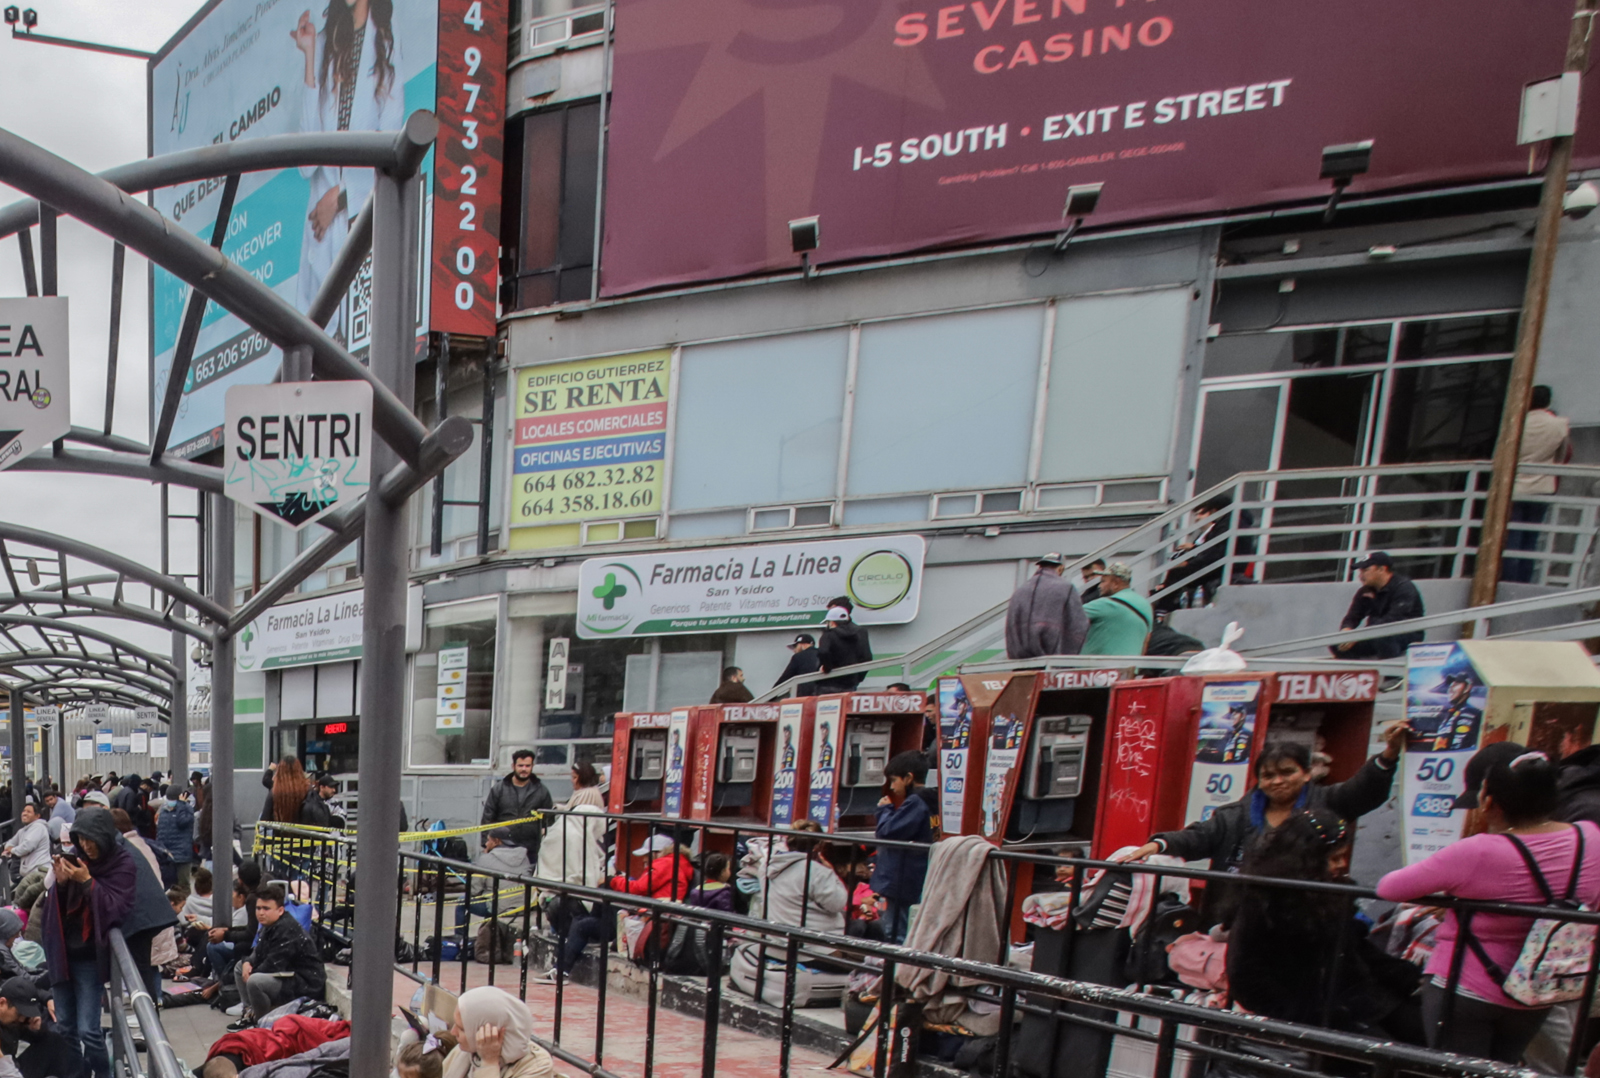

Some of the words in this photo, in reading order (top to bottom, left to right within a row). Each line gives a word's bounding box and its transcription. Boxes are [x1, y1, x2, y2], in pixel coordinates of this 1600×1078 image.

[893, 0, 1087, 46] SEVEN
[973, 16, 1174, 75] CASINO
[229, 85, 281, 142] CAMBIO
[852, 141, 893, 171] I-5
[899, 123, 1009, 165] SOUTH
[1042, 105, 1120, 142] EXIT
[1124, 101, 1148, 130] E
[1153, 78, 1293, 125] STREET
[173, 190, 195, 222] QUE
[195, 356, 215, 383] 663
[217, 344, 238, 373] 206
[528, 371, 584, 388] EDIFICIO
[586, 360, 666, 381] GUTIERREZ
[524, 389, 557, 415] SE
[564, 376, 665, 410] RENTA
[236, 412, 361, 462] SENTRI
[522, 420, 575, 440] LOCALES
[576, 411, 663, 434] COMERCIALES
[521, 448, 581, 468] OFICINAS
[582, 438, 662, 461] EJECUTIVAS
[523, 474, 556, 494] 664
[563, 464, 656, 491] 682.32.82
[521, 497, 554, 517] 664
[560, 488, 653, 514] 358.18.60
[649, 557, 744, 586] Farmacia
[749, 556, 776, 579] La
[781, 552, 842, 577] Linea
[706, 587, 729, 598] San
[734, 584, 774, 596] Ysidro
[267, 608, 314, 633] Farmacia
[317, 606, 331, 624] La
[650, 603, 691, 615] Genericos
[699, 601, 732, 612] Patente
[739, 598, 781, 610] Vitaminas
[787, 596, 809, 608] Drug
[295, 631, 308, 640] San
[309, 628, 331, 637] Ysidro
[670, 620, 698, 628] Porque
[708, 616, 730, 626] salud
[767, 612, 811, 624] importante
[549, 642, 566, 705] ATM
[1056, 670, 1119, 689] TELNOR
[1277, 673, 1376, 701] TELNOR
[36, 708, 57, 716] LINEA
[136, 711, 157, 720] SENTRI
[851, 695, 923, 713] TELNOR
[324, 722, 347, 735] ABIERTO
[946, 753, 963, 769] 50
[1416, 757, 1456, 782] 50
[774, 771, 795, 789] 200
[810, 771, 833, 790] 200
[1205, 773, 1233, 794] 50
